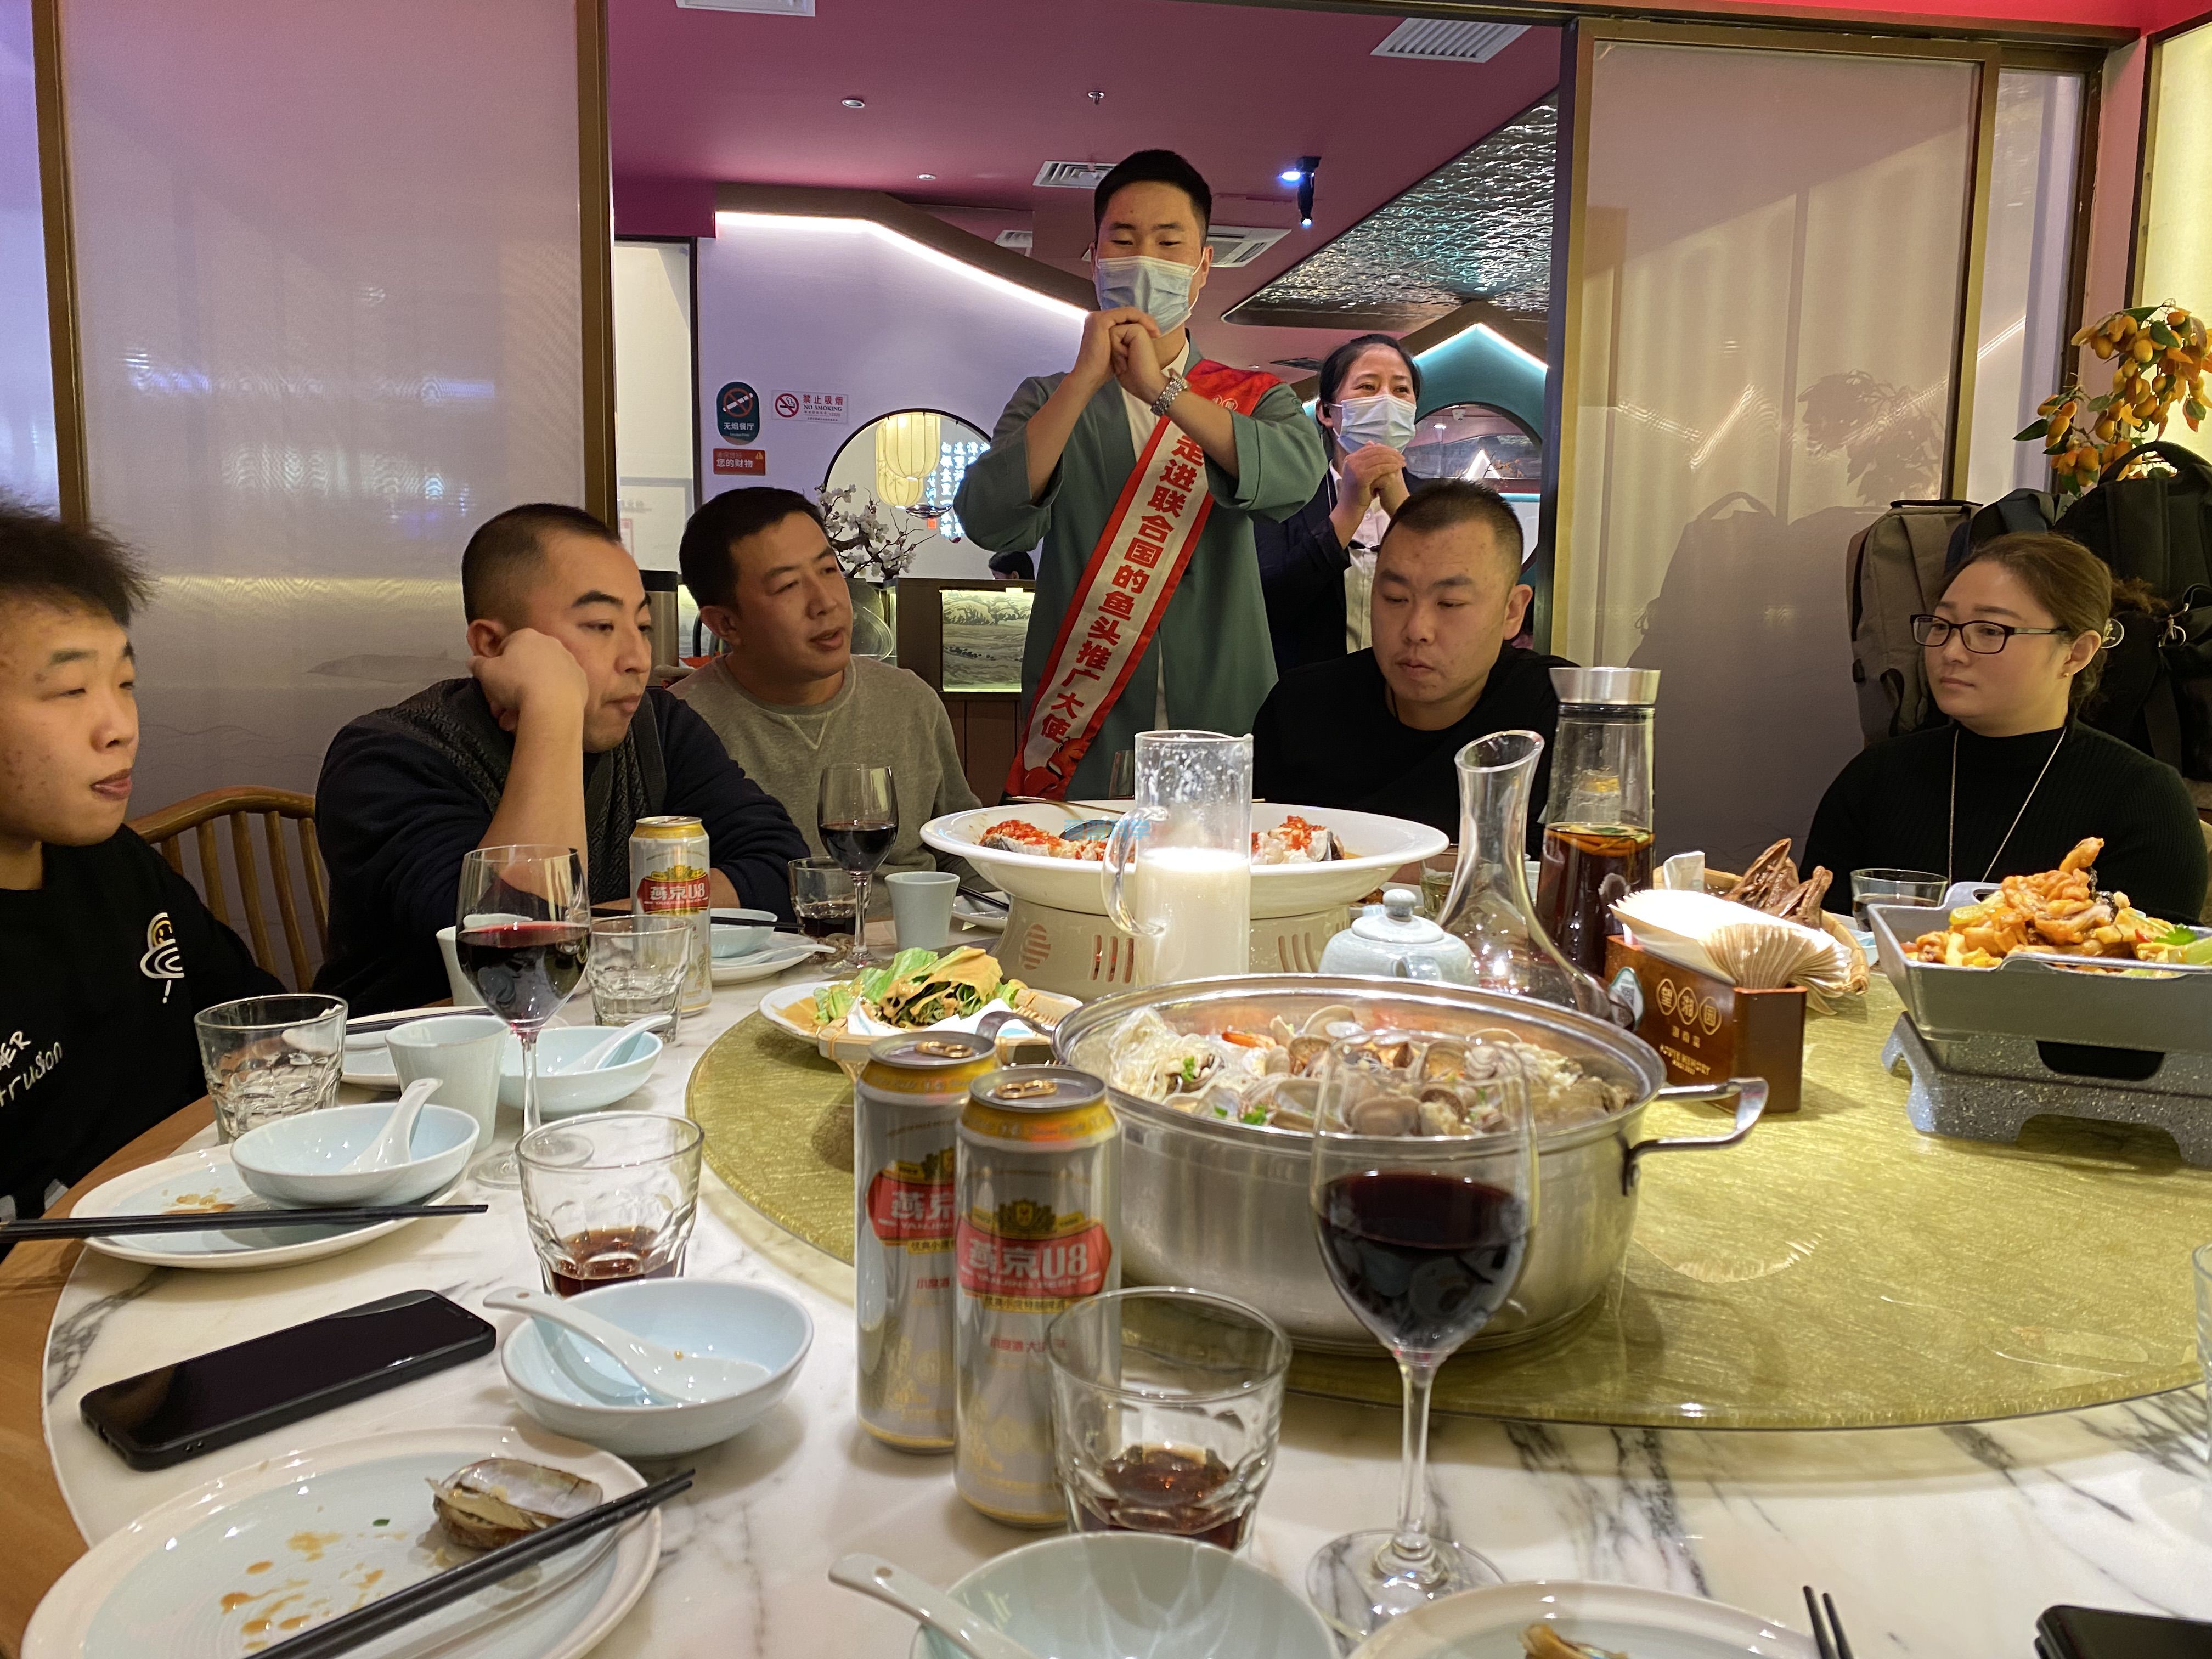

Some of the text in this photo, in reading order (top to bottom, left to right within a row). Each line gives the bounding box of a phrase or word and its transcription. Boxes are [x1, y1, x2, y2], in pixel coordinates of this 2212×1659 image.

[803, 394, 843, 405] 禁止吸烟
[716, 458, 753, 467] 您的财物
[1040, 435, 1204, 744] 走进联合国的鱼头推广大使
[650, 882, 706, 900] 燕京U8
[969, 1238, 1087, 1279] 燕京U8
